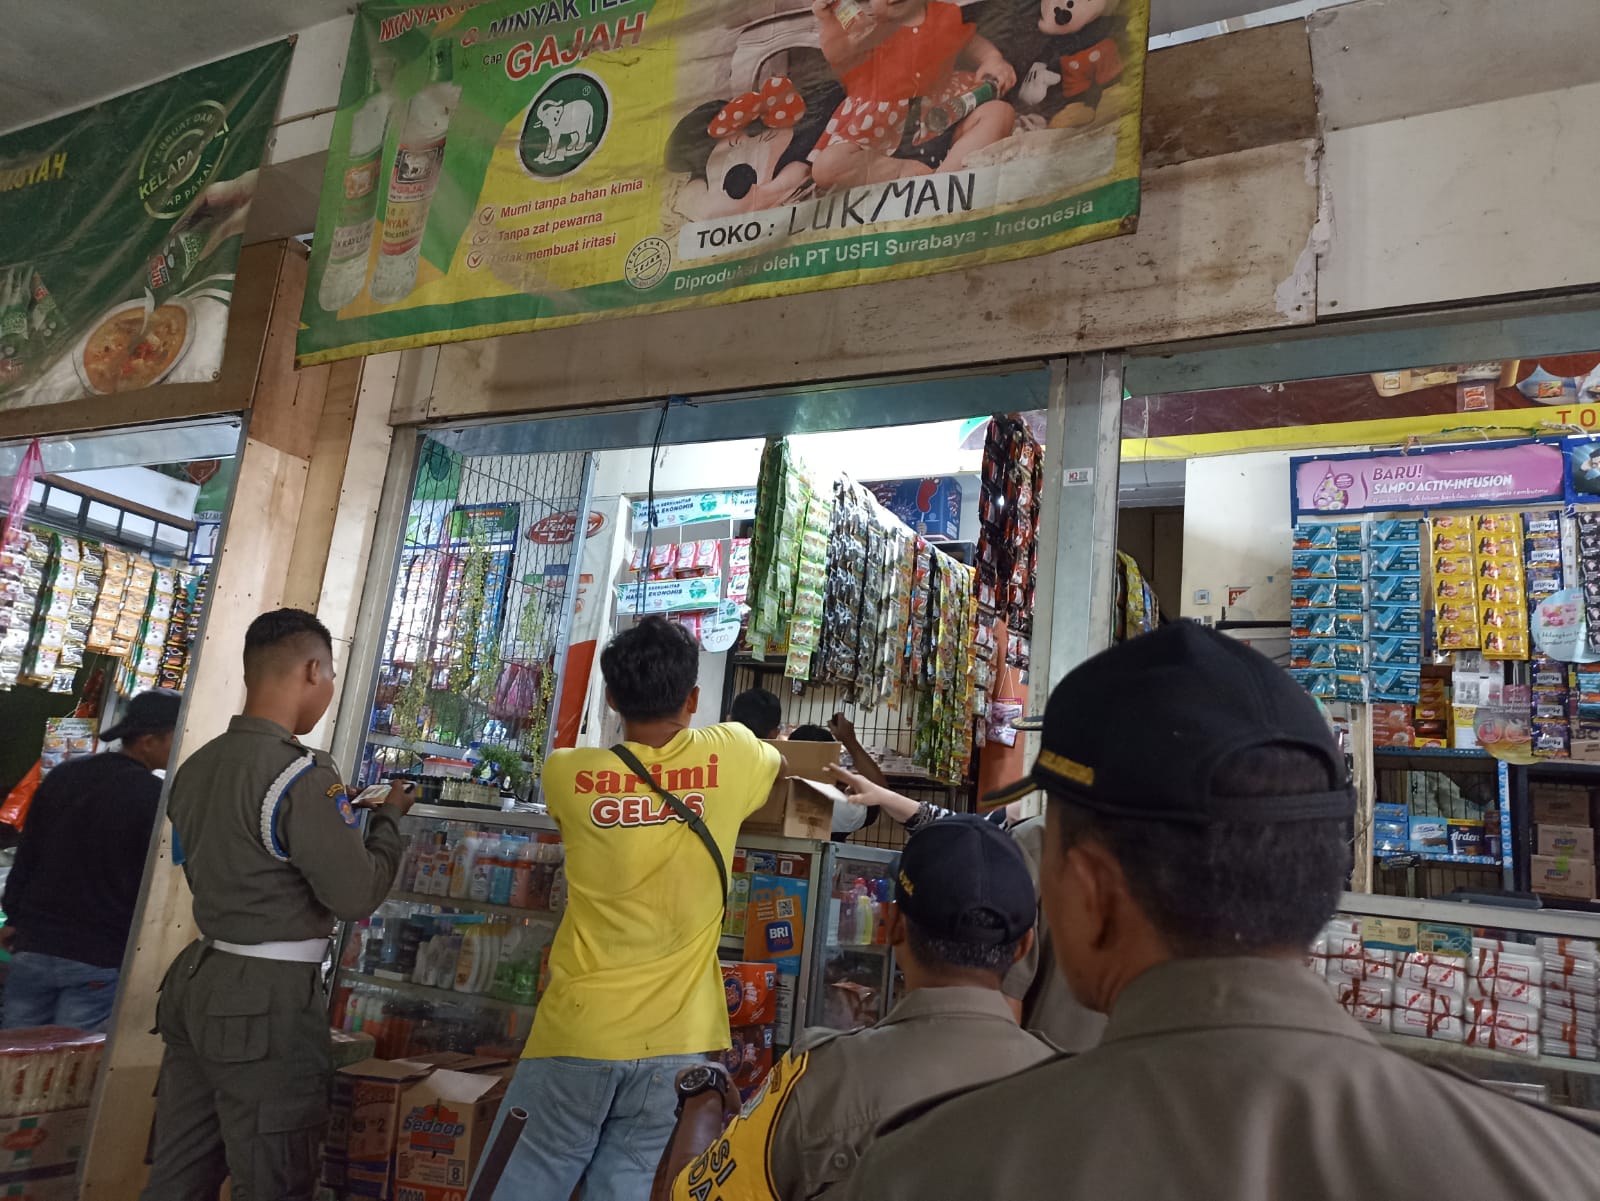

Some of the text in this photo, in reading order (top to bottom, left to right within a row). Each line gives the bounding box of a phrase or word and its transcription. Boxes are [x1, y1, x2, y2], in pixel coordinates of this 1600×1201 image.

[488, 0, 580, 39] MINYAK
[482, 12, 646, 81] Cap GAJAH
[139, 149, 194, 200] KELAPA
[500, 179, 644, 218] Murni tanpa bahan kimia
[787, 172, 977, 236] LUKMAN
[498, 212, 602, 243] Tanpa zat pewarna
[526, 241, 580, 260] membuat
[582, 232, 617, 251] iritasi
[762, 253, 800, 273] oleh
[805, 247, 830, 267] PT
[836, 240, 880, 262] USFI
[885, 230, 977, 256] Surabaya
[995, 199, 1094, 237] Indonesia
[1373, 465, 1423, 481] BARU!
[1373, 474, 1514, 495] SAMPO ACTIV-INFUSION
[591, 793, 705, 828] GELAS
[769, 926, 789, 939] BRI
